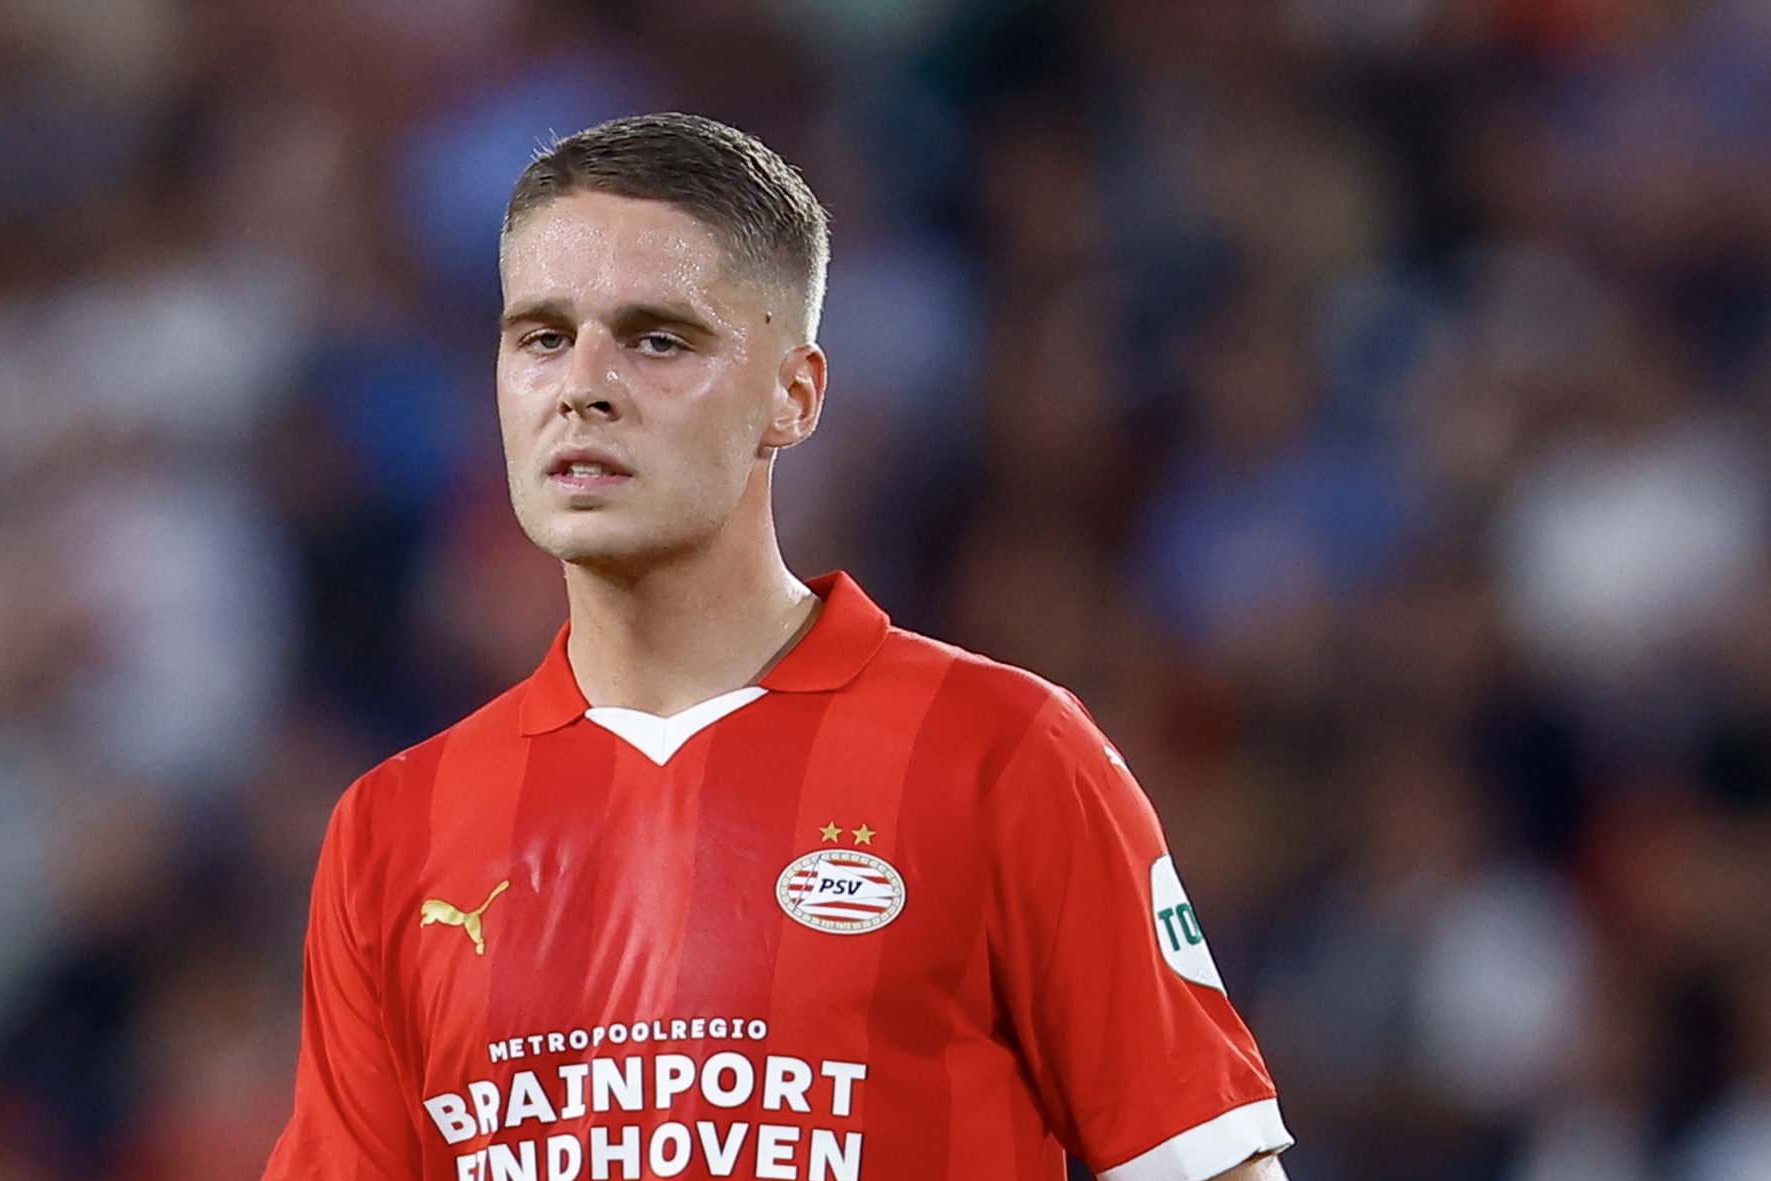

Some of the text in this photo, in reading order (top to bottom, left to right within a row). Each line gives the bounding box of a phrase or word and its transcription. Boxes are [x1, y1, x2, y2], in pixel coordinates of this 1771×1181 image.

[819, 878, 863, 895] PSV
[489, 1018, 768, 1062] METROPOOLREGIO
[424, 1052, 868, 1144] BRAINPORT
